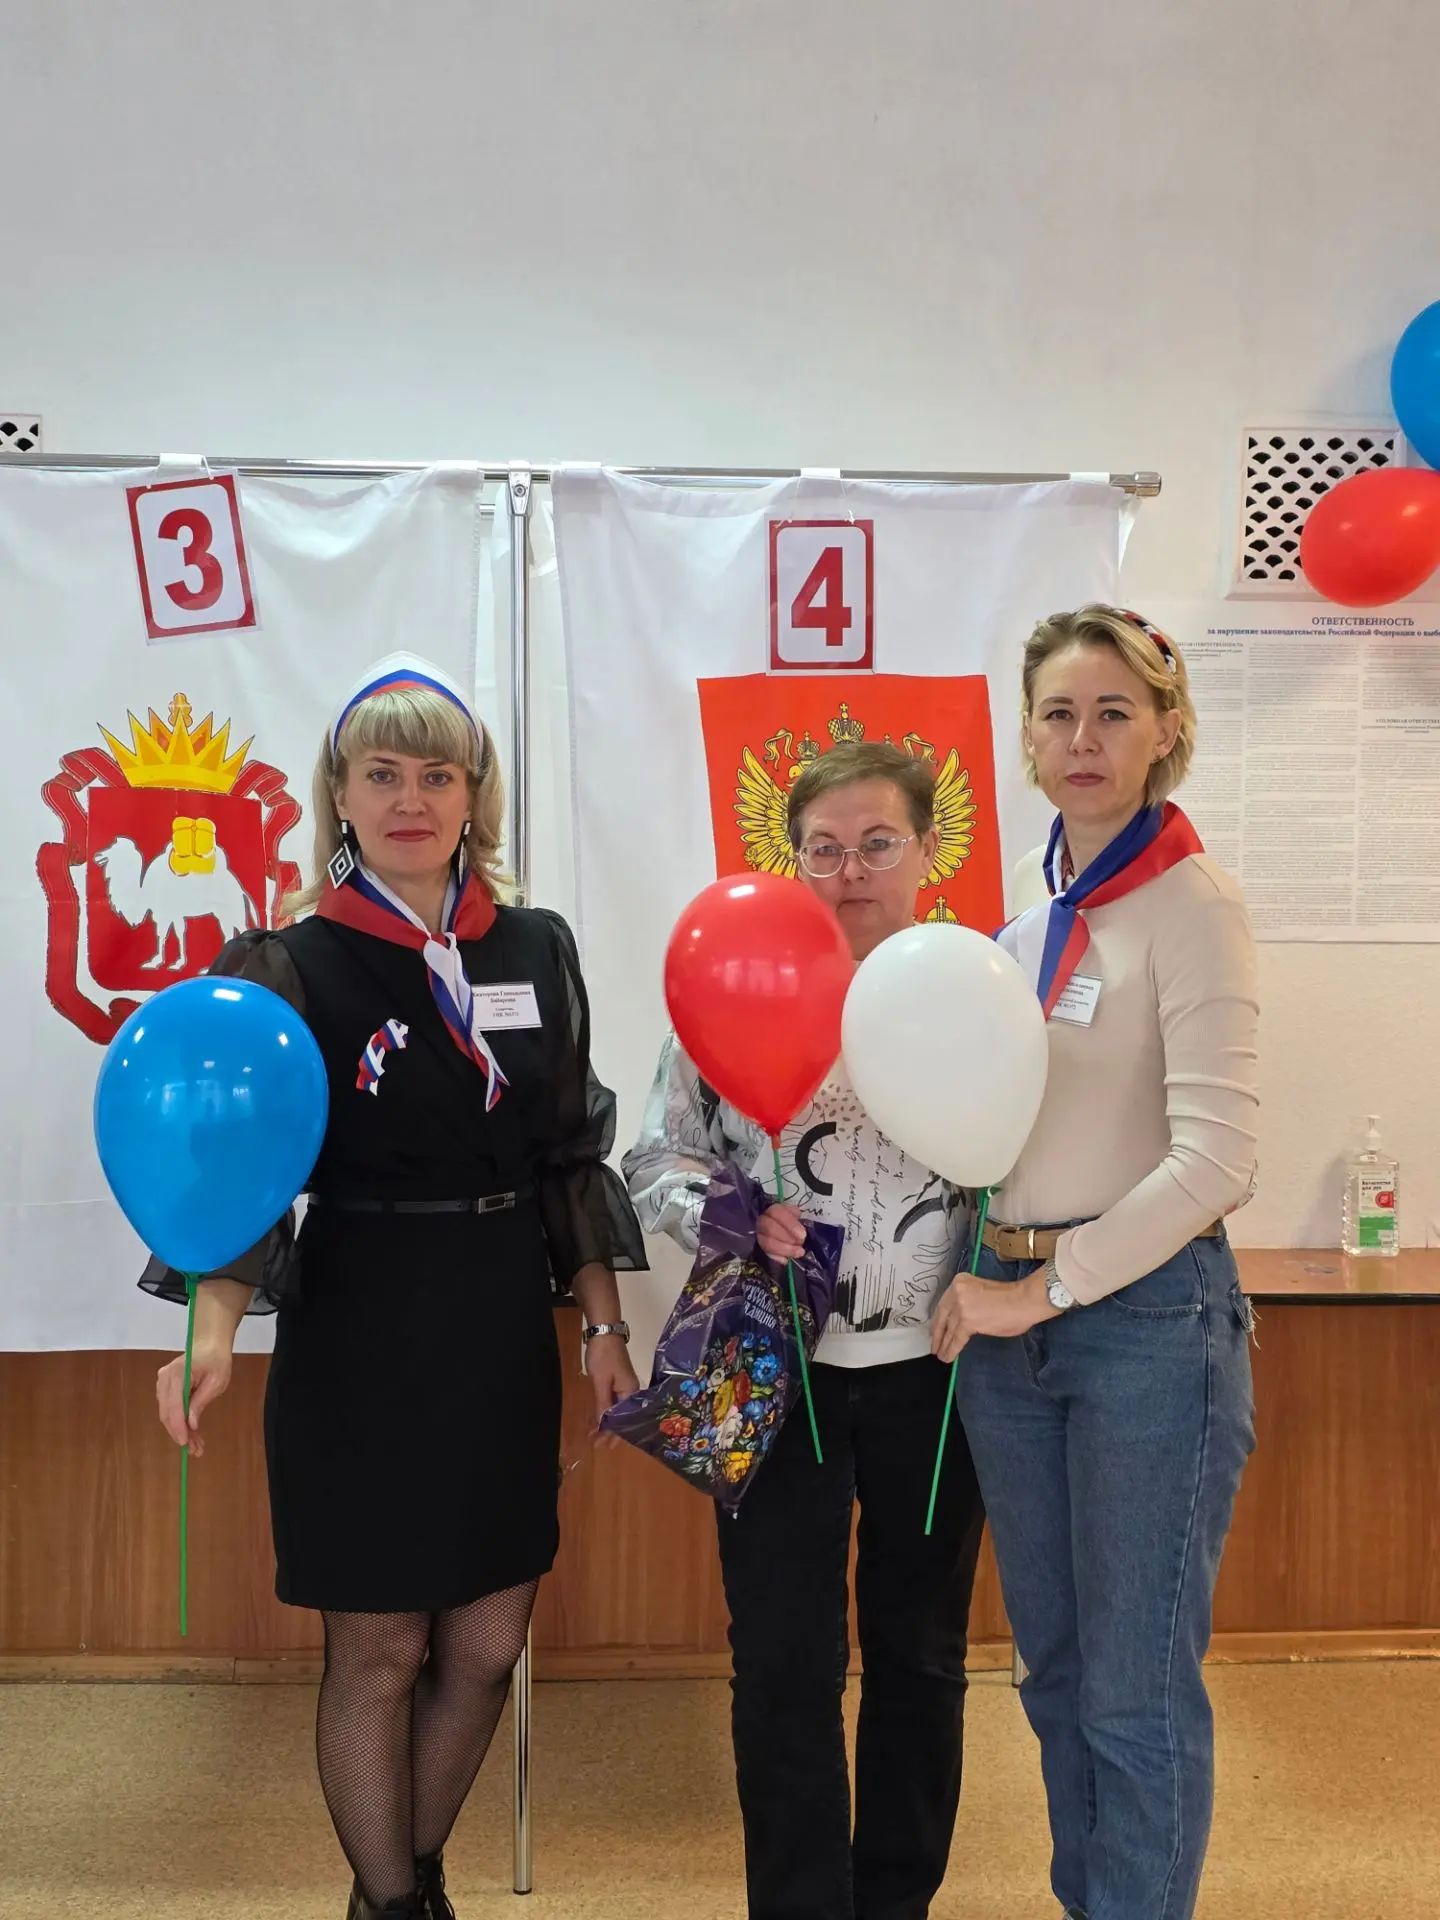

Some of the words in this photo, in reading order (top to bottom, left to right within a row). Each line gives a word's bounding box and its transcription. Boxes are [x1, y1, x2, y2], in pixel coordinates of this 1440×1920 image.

[157, 508, 224, 611] 3
[790, 546, 853, 647] 4
[1311, 616, 1415, 627] ОТВЕТСТВЕННОСТЬ
[1217, 629, 1259, 637] нарушение
[1260, 629, 1327, 637] законодательства
[1328, 628, 1372, 637] Российской
[1373, 629, 1415, 639] Федерации
